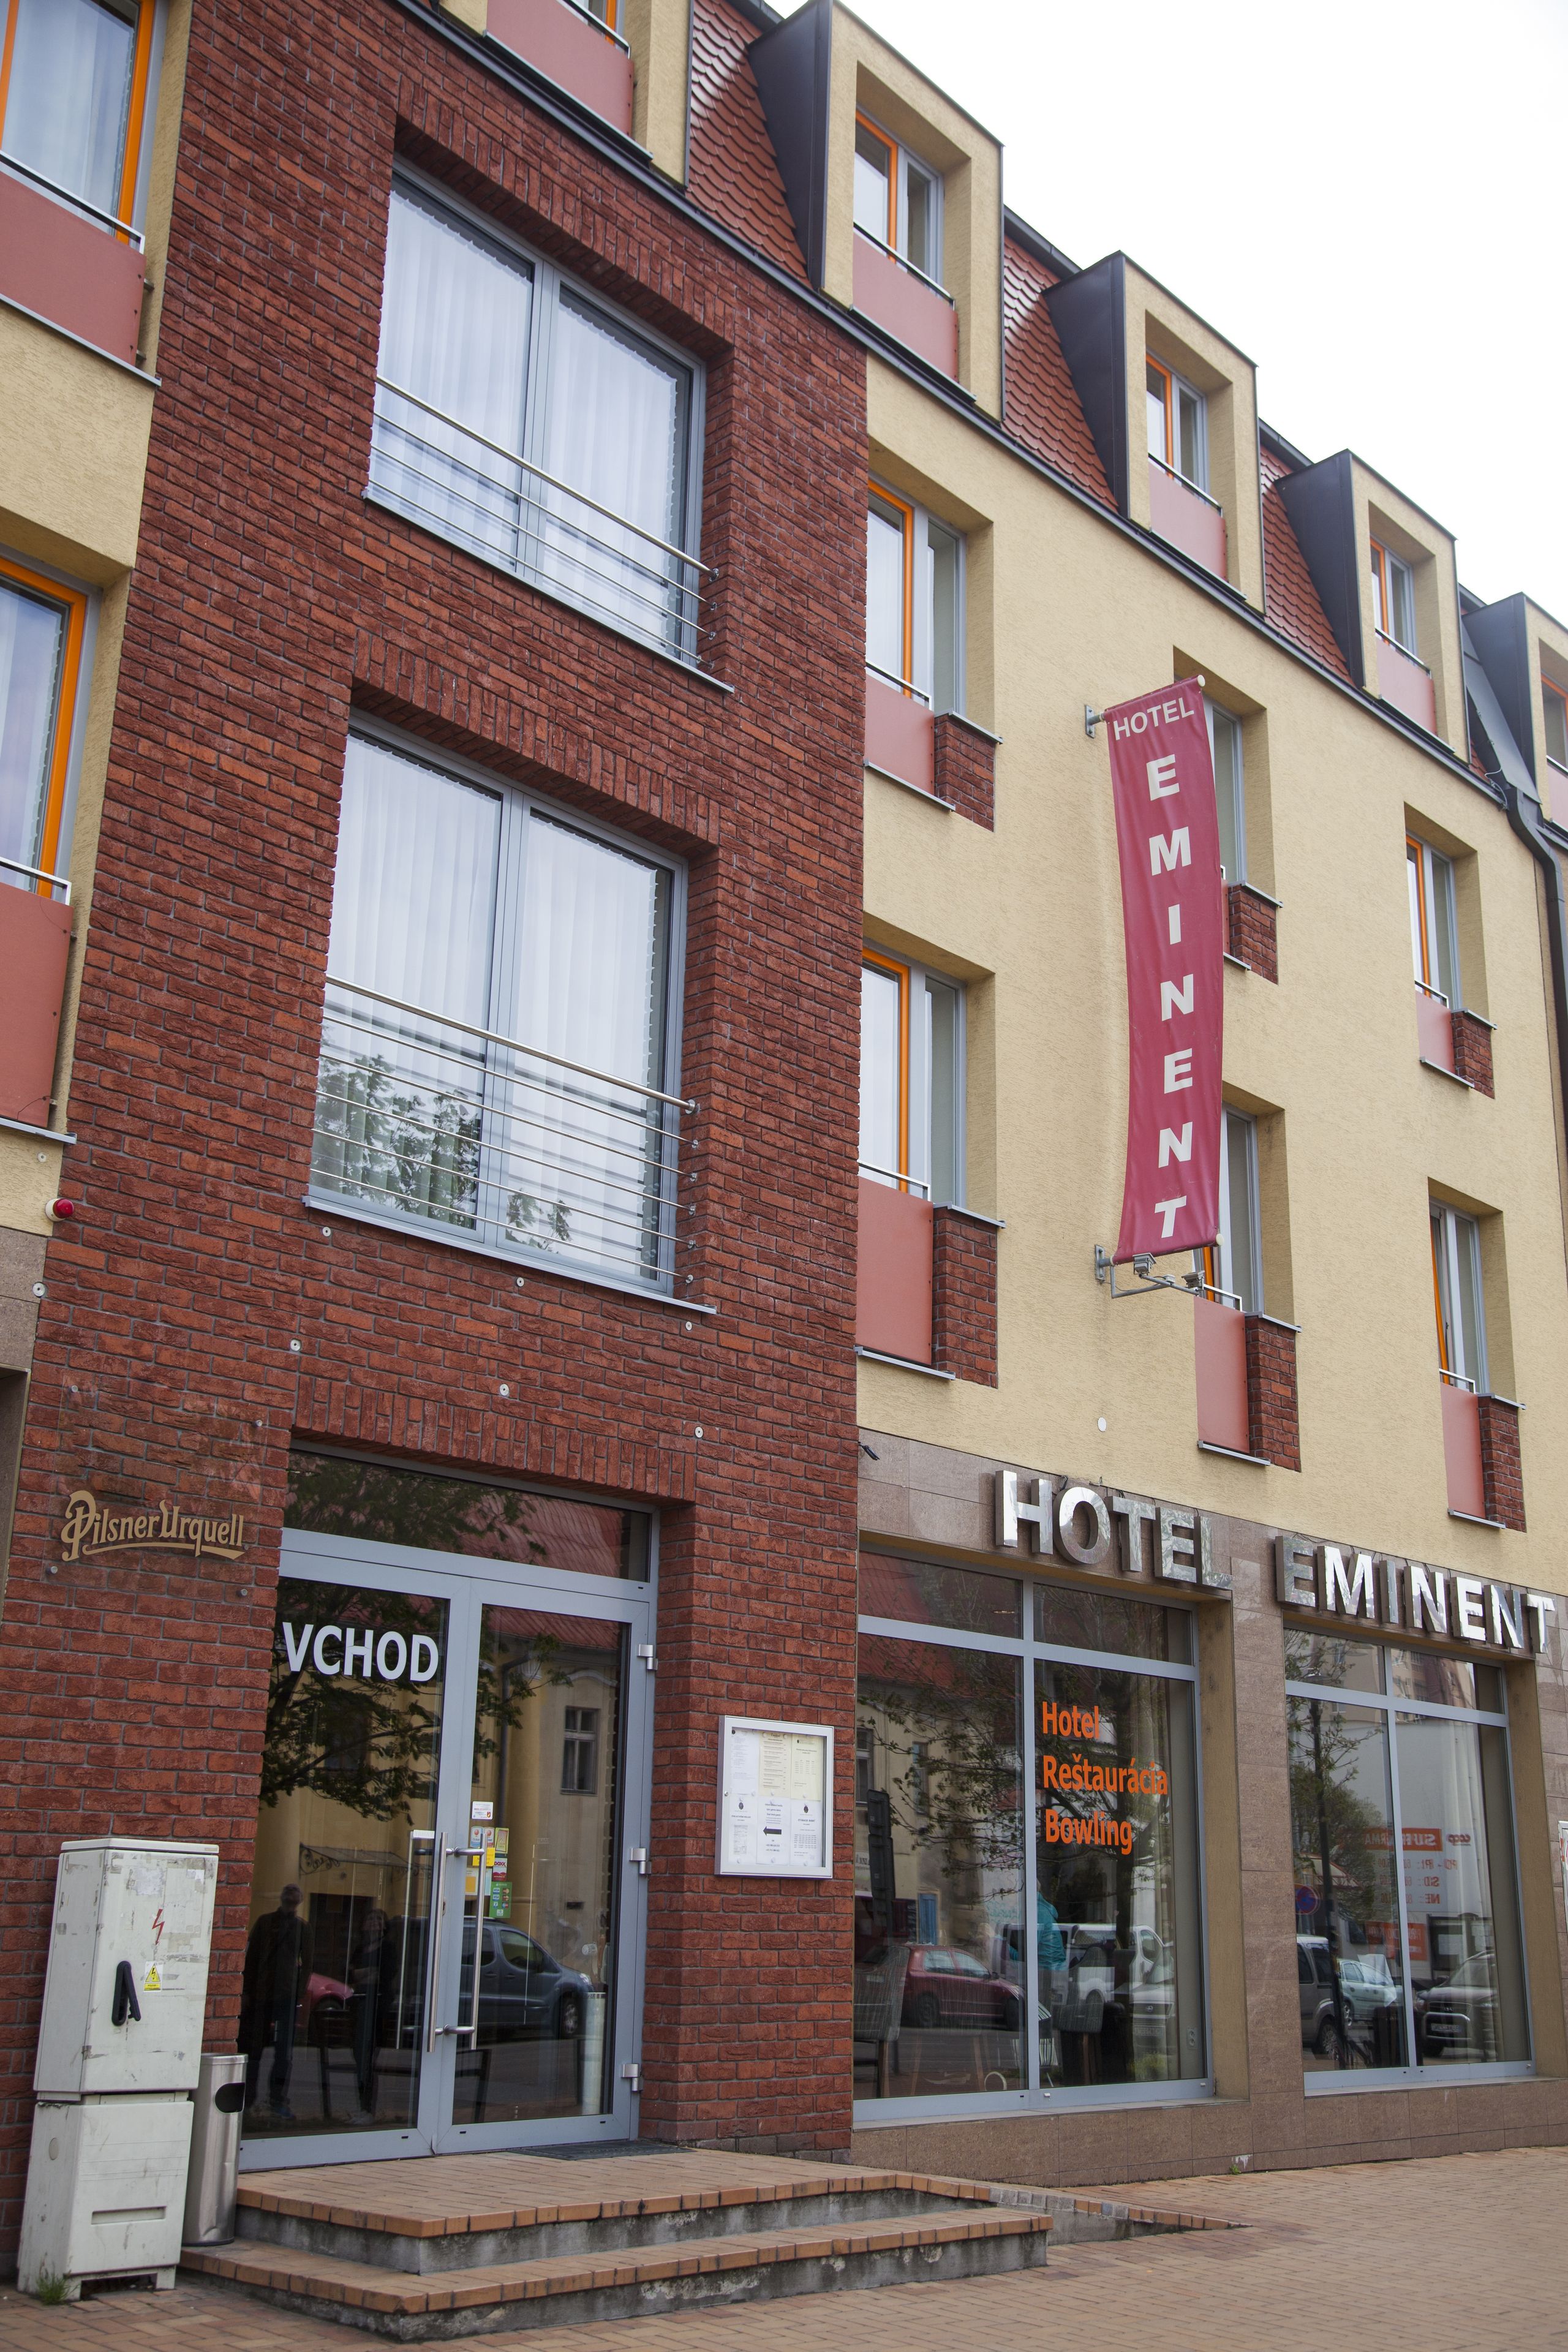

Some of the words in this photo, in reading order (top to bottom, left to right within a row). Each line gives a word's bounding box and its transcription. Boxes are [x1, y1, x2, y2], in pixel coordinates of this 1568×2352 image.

[1112, 696, 1194, 740] HOTEL
[1146, 754, 1194, 1239] EMINENT
[61, 1490, 159, 1561] Pilsner
[158, 1499, 244, 1557] Urquell
[995, 1470, 1232, 1590] HOTEL
[1275, 1536, 1555, 1654] EMINENT
[282, 1622, 439, 1682] VCHOD
[1042, 1701, 1099, 1740] Hotel
[1043, 1753, 1168, 1795] Reštaurácia
[1046, 1809, 1133, 1855] Bowling
